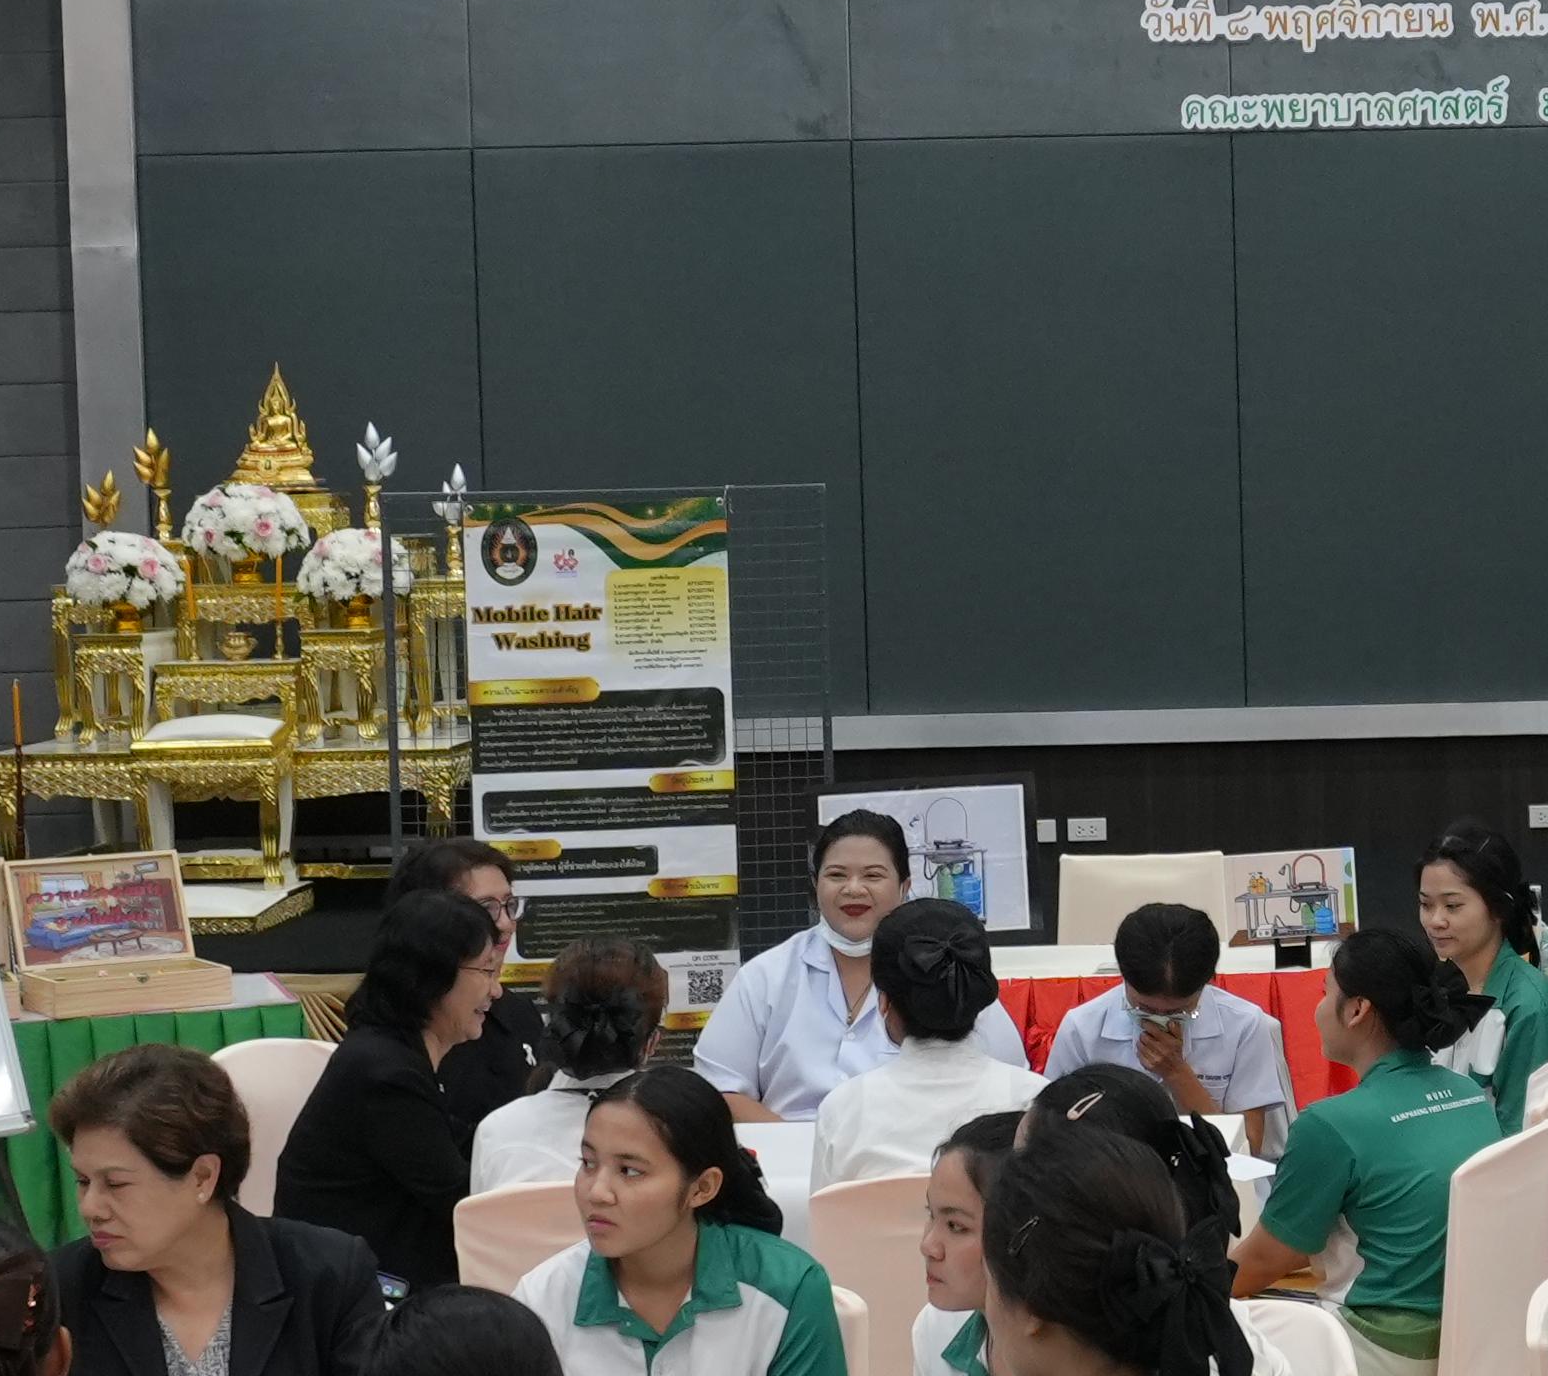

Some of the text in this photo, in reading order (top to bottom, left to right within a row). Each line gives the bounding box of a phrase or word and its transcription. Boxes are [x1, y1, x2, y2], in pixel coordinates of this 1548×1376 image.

[1184, 81, 1508, 125] คณะพยาบาลศาสตร์
[471, 603, 603, 625] Mobile Hair
[492, 631, 592, 652] Washing
